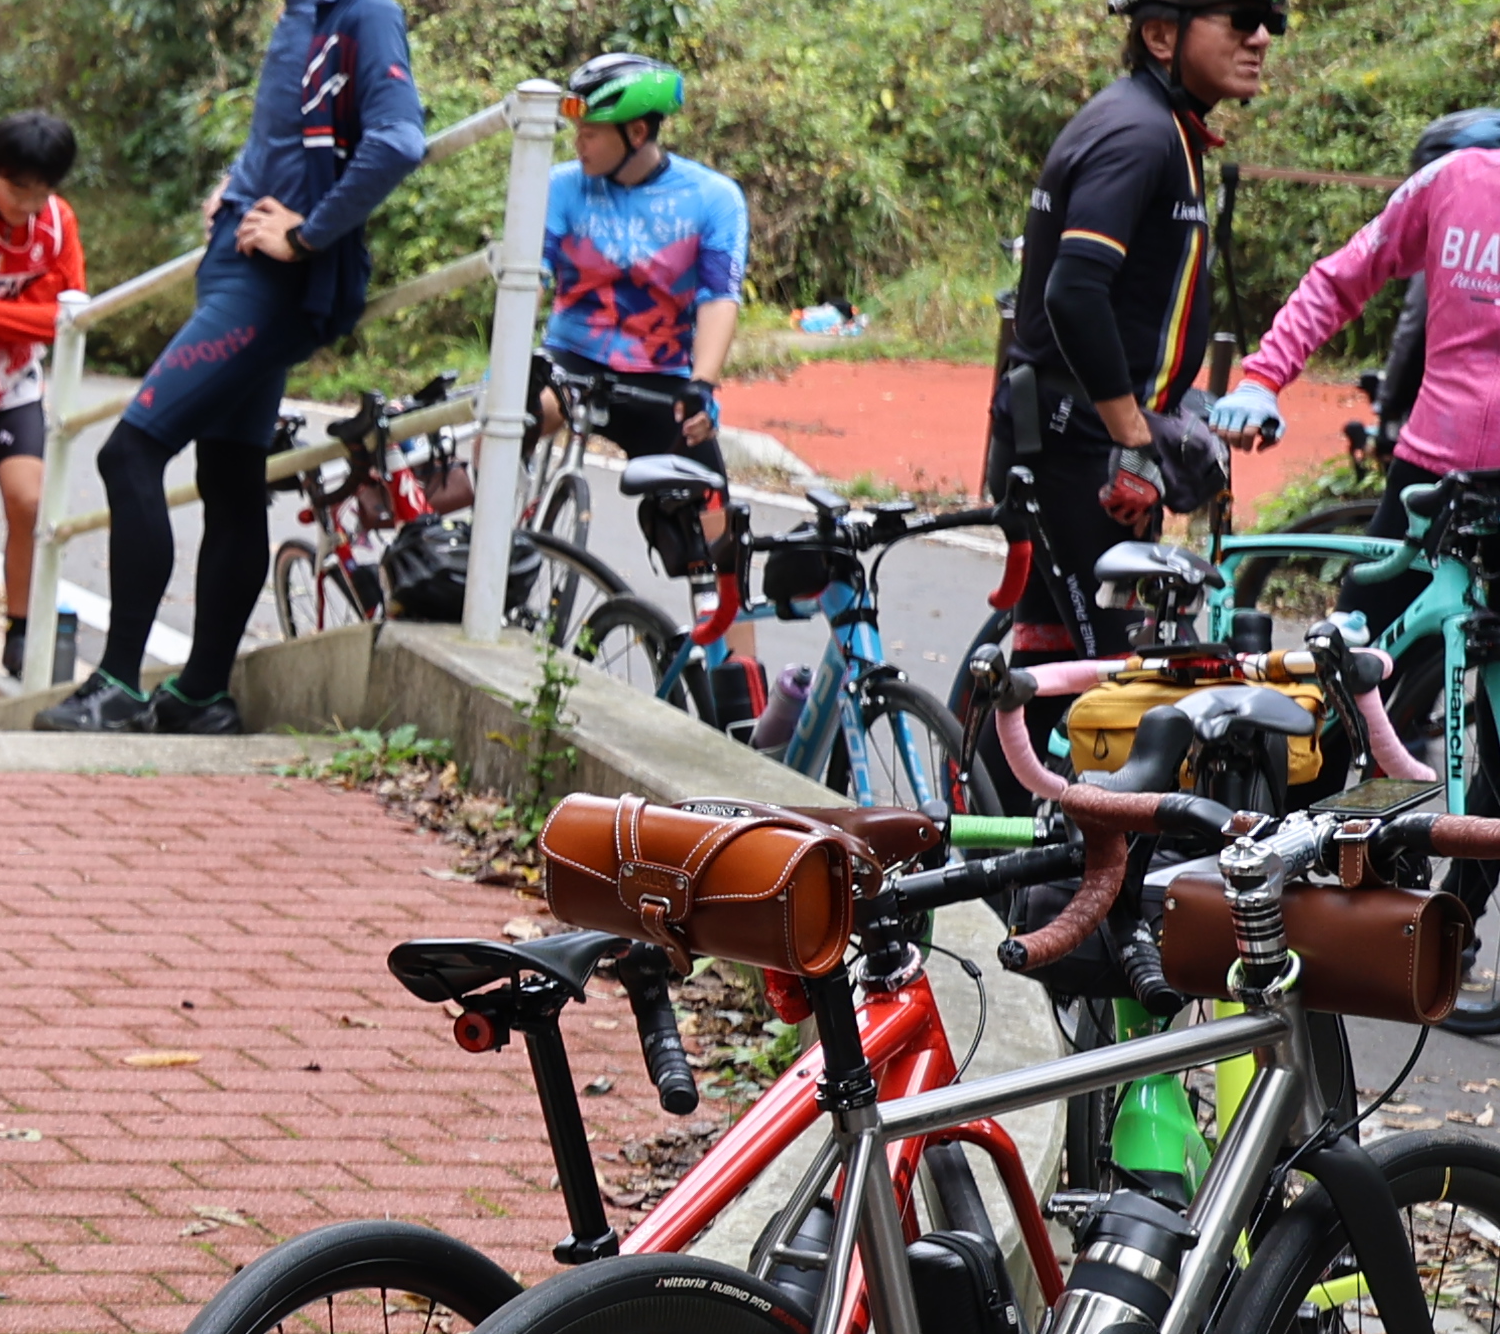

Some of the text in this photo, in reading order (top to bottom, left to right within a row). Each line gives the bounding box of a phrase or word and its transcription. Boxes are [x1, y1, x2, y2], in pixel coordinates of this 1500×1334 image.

[1450, 666, 1466, 782] Bianchi
[693, 803, 736, 818] BROOKS
[662, 1275, 773, 1314] vittoria RUBINO PRO
